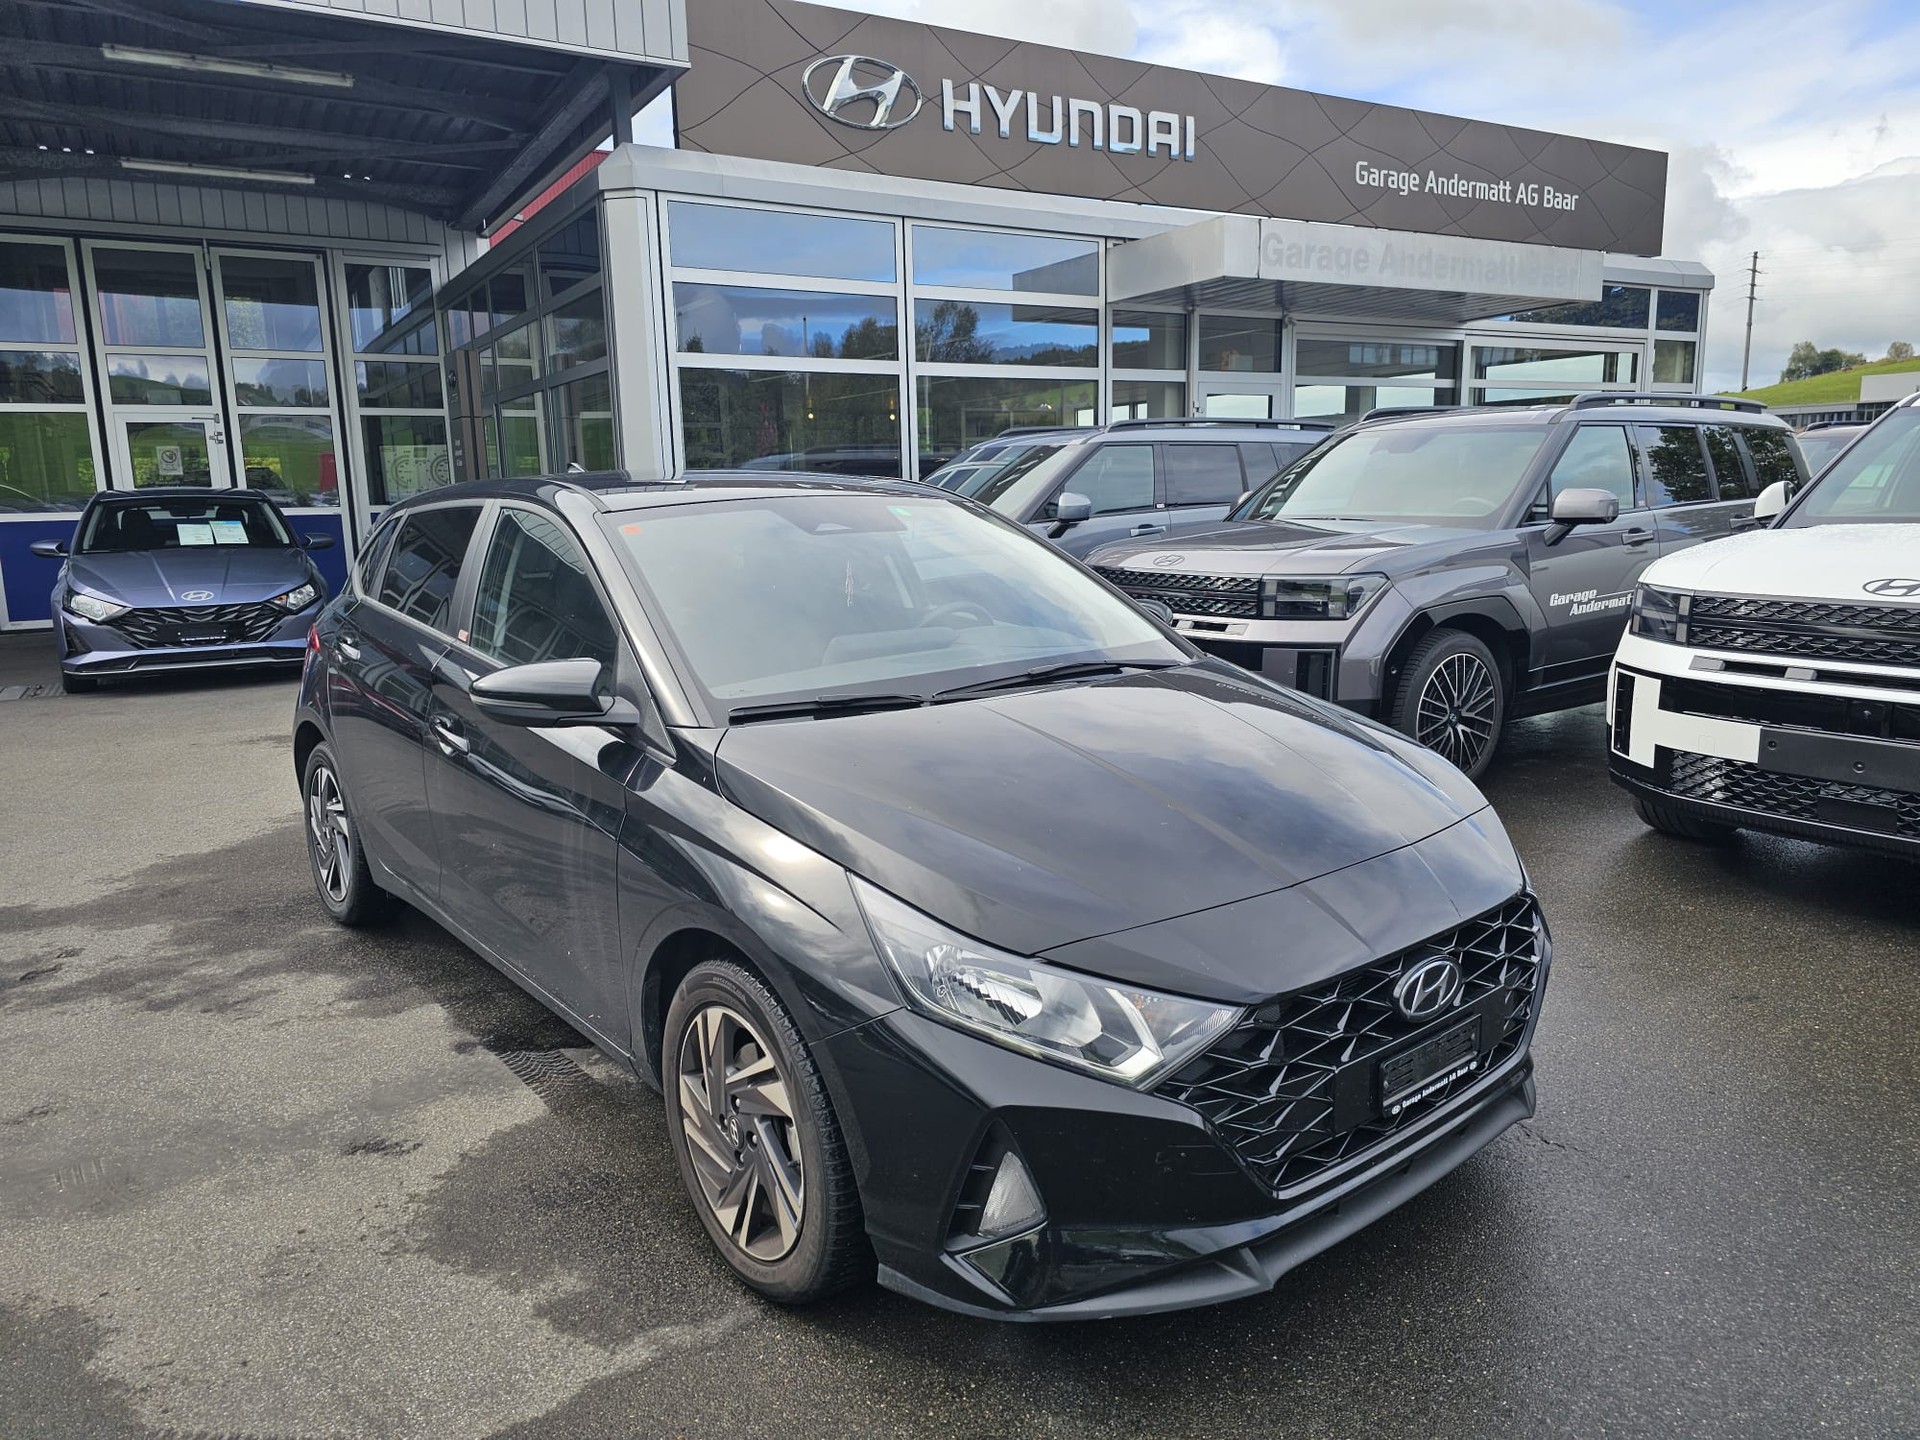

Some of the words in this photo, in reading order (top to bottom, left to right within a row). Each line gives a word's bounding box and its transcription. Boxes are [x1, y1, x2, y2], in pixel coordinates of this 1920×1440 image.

[942, 78, 1195, 162] HYUNDAI
[1355, 160, 1420, 196] Garage
[1425, 170, 1512, 204] Andermatt
[1516, 183, 1539, 207] AG
[1543, 186, 1579, 211] Baar
[1262, 231, 1370, 279] Garage
[1549, 589, 1598, 607] Garage
[1569, 593, 1634, 617] Andermat
